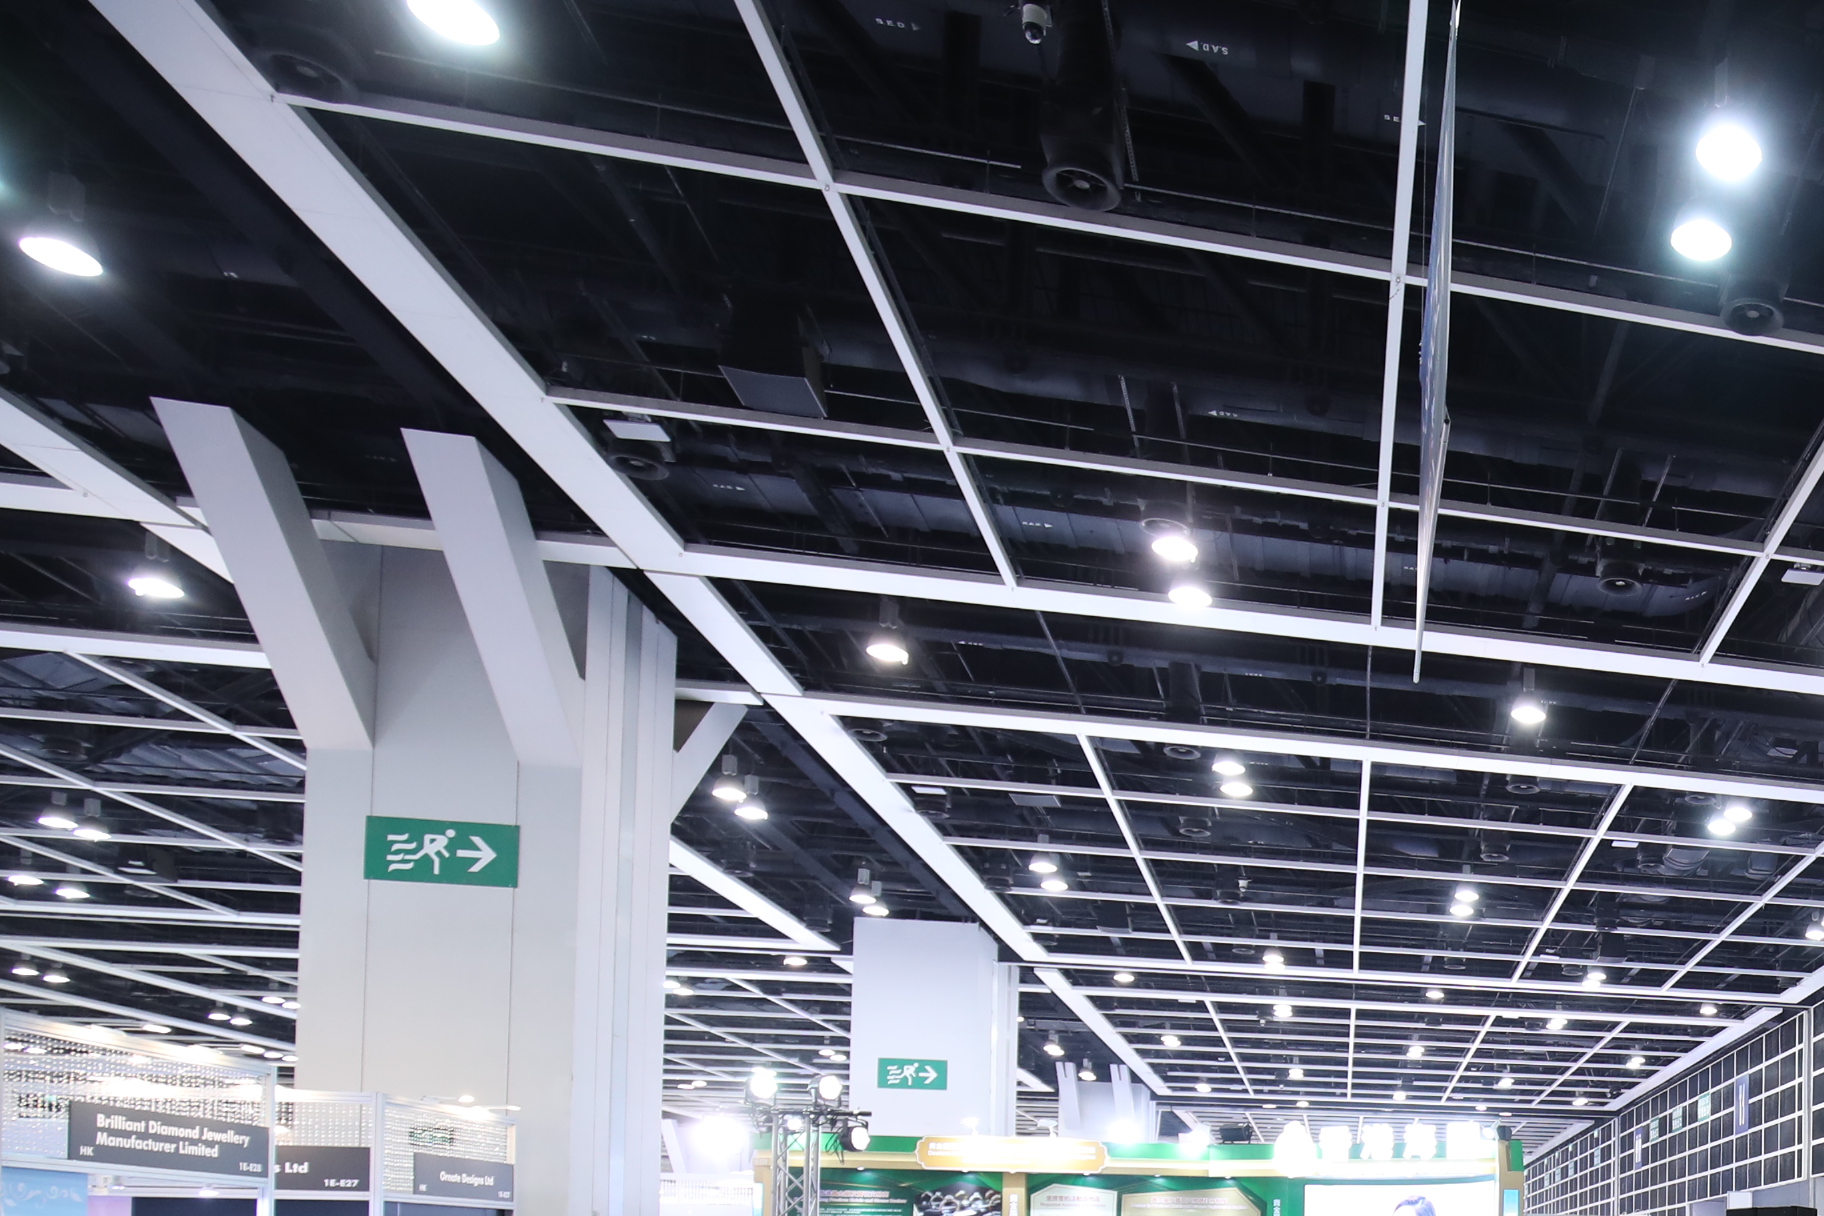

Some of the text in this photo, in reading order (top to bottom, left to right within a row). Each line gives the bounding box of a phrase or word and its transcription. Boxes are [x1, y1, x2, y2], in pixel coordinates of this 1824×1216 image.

[96, 1113, 250, 1149] Brilliant Diamond Jewellery
[79, 1146, 94, 1157] HK
[96, 1132, 219, 1158] Manufacturer Limited
[284, 1162, 310, 1174] Ltd
[323, 1178, 359, 1188] 1E-E27
[439, 1170, 495, 1187] Ornate Designs Ltd
